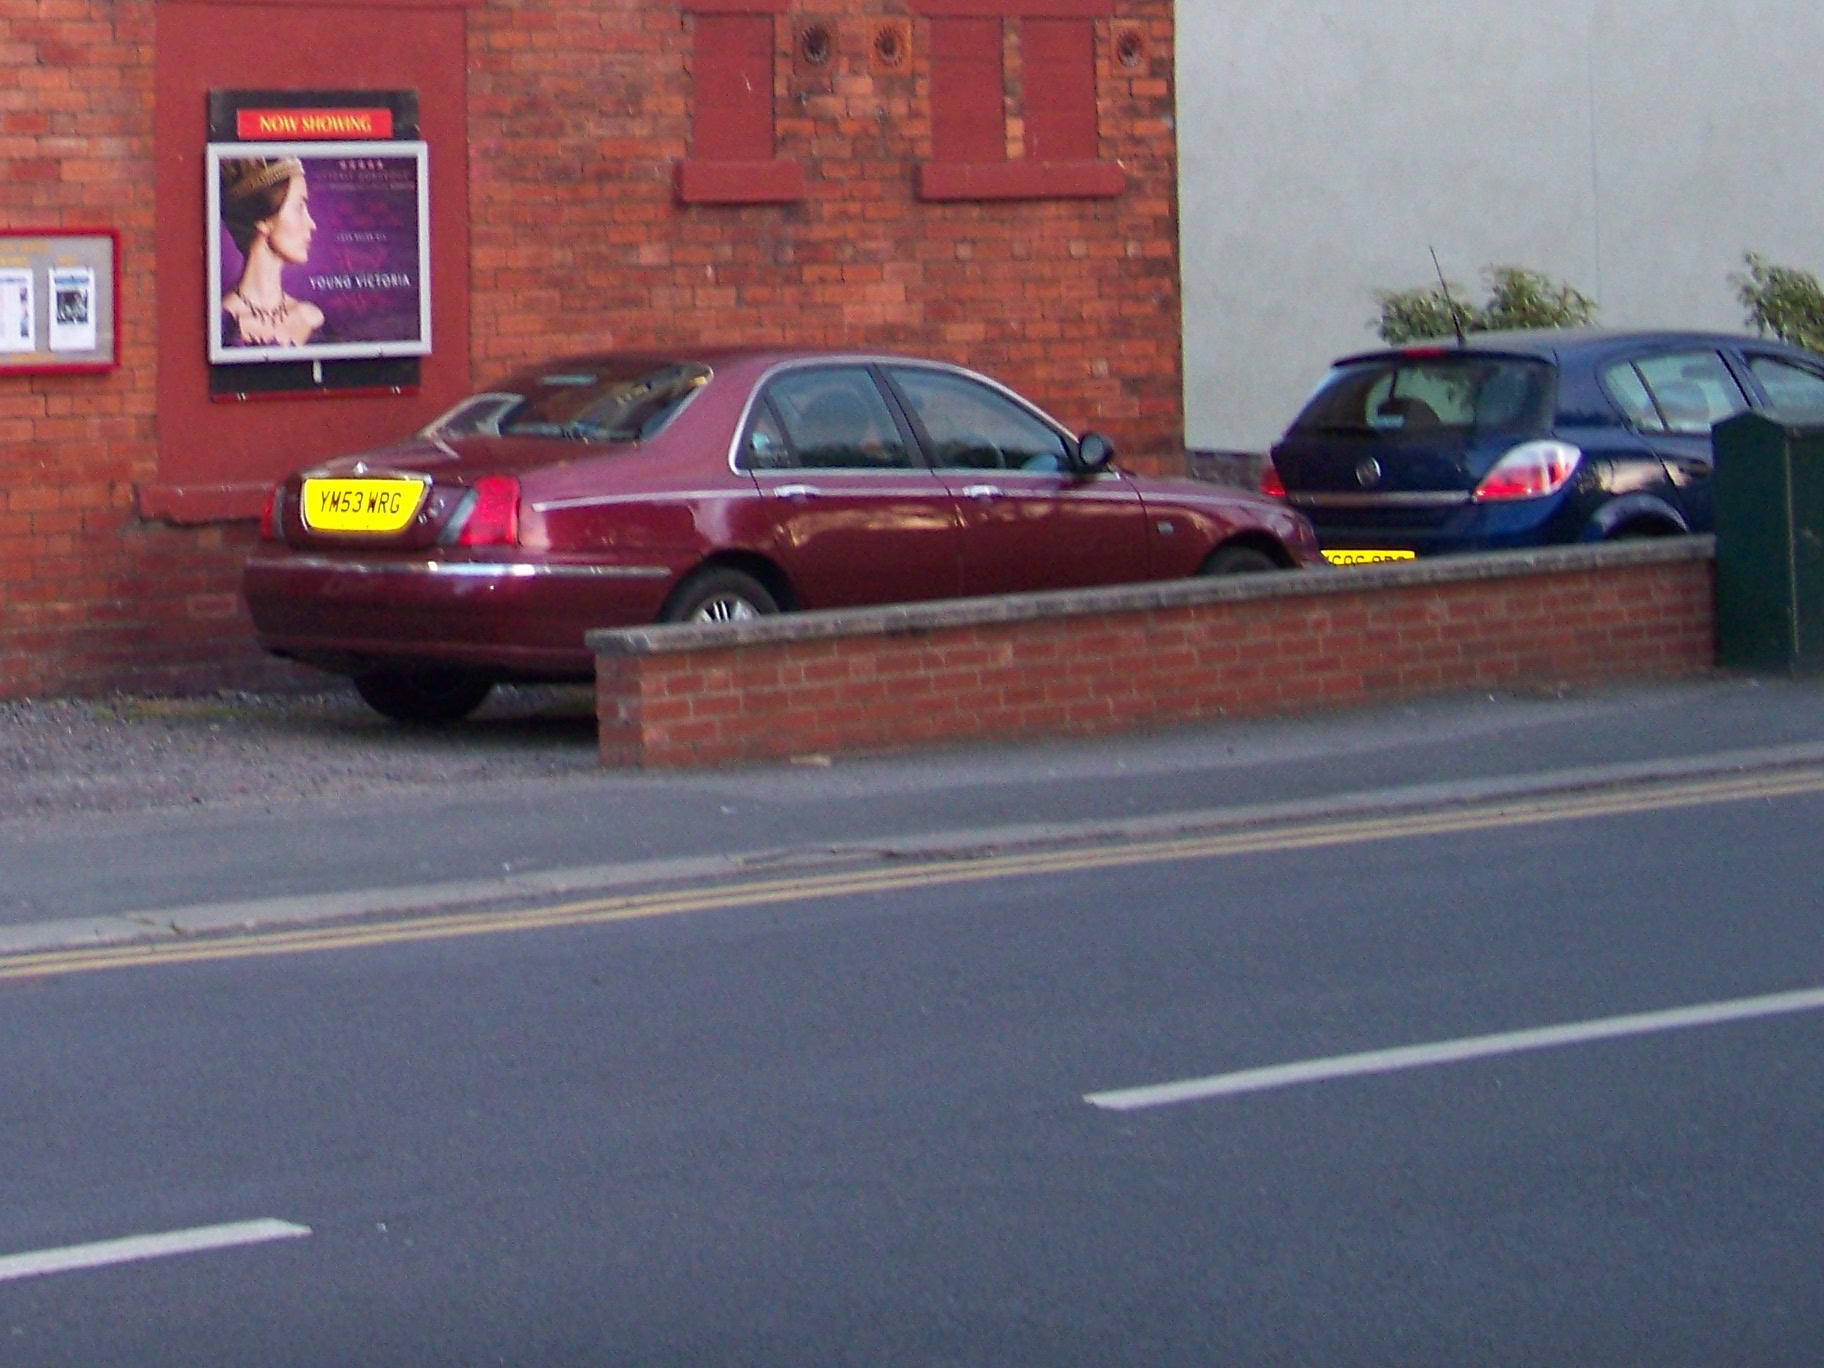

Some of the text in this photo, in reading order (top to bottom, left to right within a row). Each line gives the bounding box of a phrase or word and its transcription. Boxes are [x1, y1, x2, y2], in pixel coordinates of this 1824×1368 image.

[260, 114, 373, 133] NOW SHOWING
[309, 272, 411, 290] YOUNG VICTORIA
[320, 490, 402, 514] YM53 WRG
